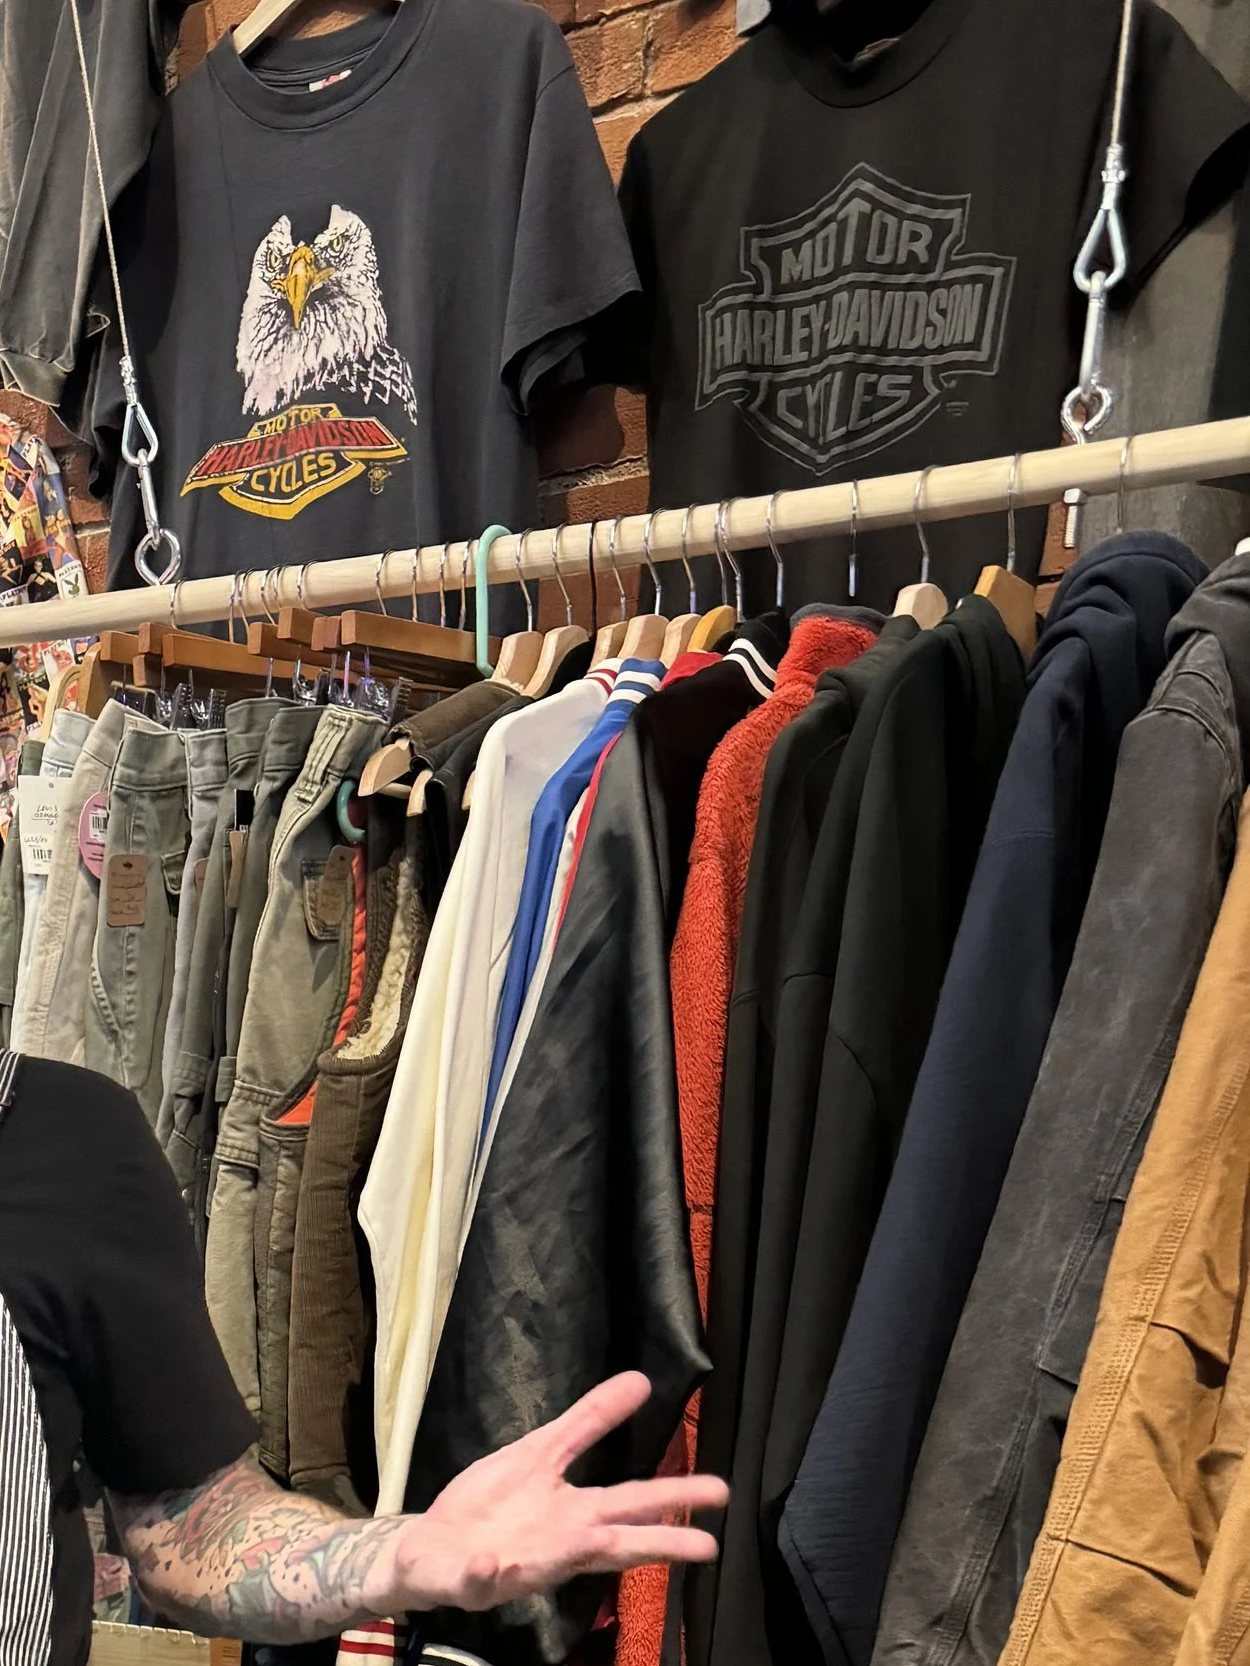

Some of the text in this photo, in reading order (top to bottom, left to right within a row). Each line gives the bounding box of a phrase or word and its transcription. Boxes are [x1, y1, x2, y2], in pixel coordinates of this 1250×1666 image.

[781, 197, 933, 284] MOTOR
[715, 283, 984, 370] HARLEY-DAVIDSON
[262, 407, 322, 435] MOTOR
[777, 370, 914, 445] CYCLES
[197, 418, 395, 476] HARLEY-DAVIDSON
[250, 453, 337, 493] CYCLES
